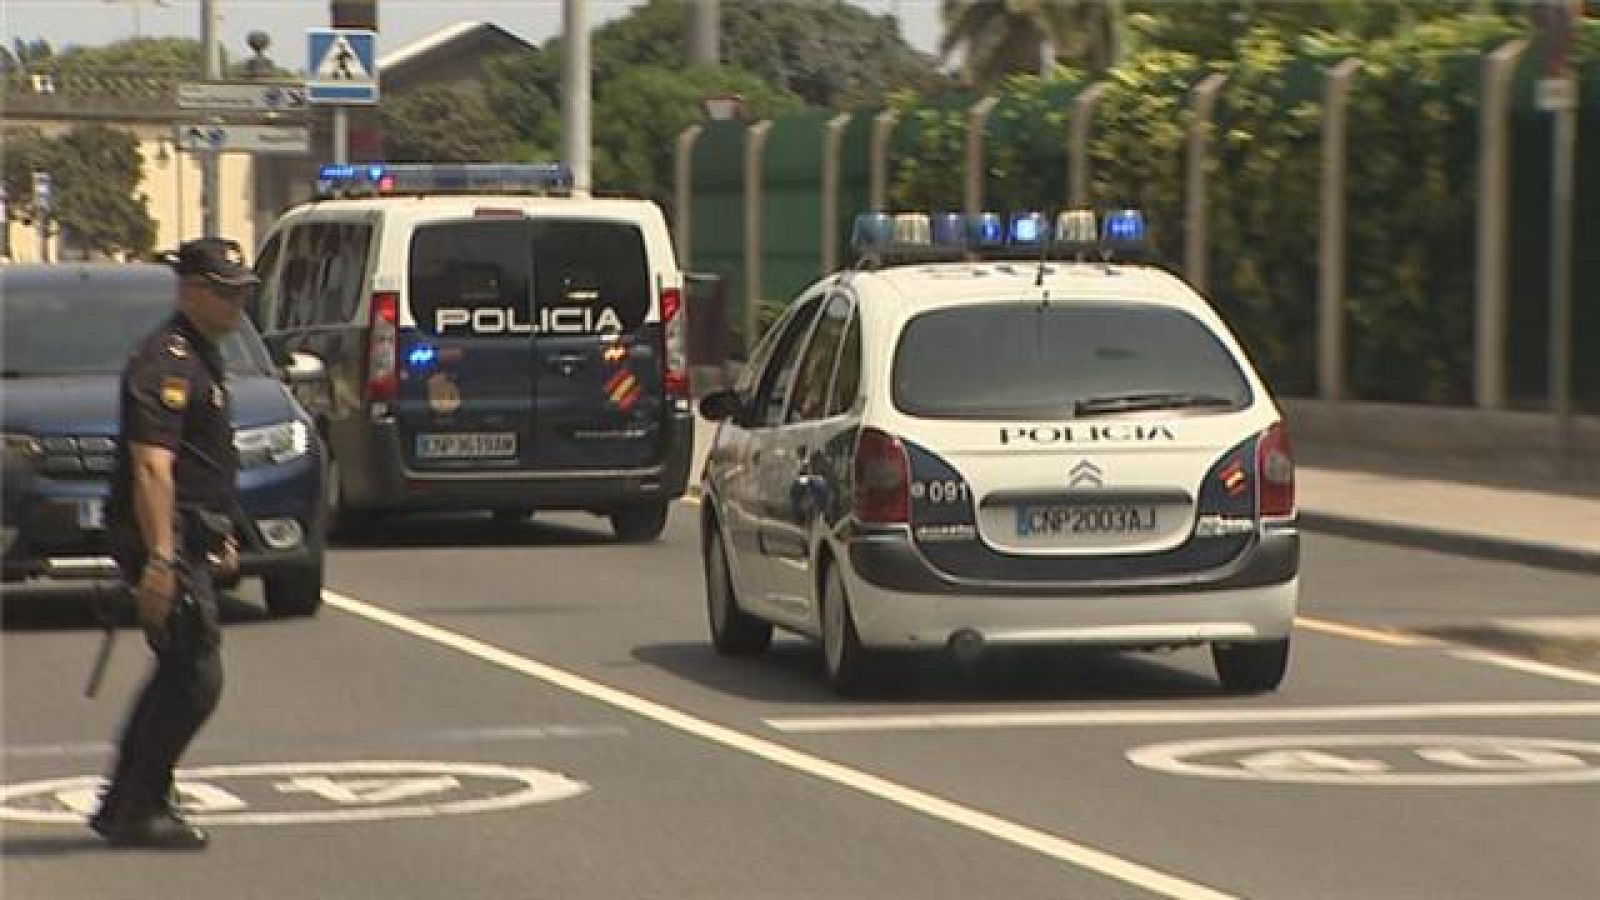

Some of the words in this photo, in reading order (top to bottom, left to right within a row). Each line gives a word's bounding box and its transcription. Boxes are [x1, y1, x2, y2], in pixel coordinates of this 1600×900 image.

[435, 306, 623, 334] POLICIA
[999, 424, 1176, 445] POLICIA
[929, 480, 967, 503] 091
[1031, 506, 1157, 533] CNP2003AJ
